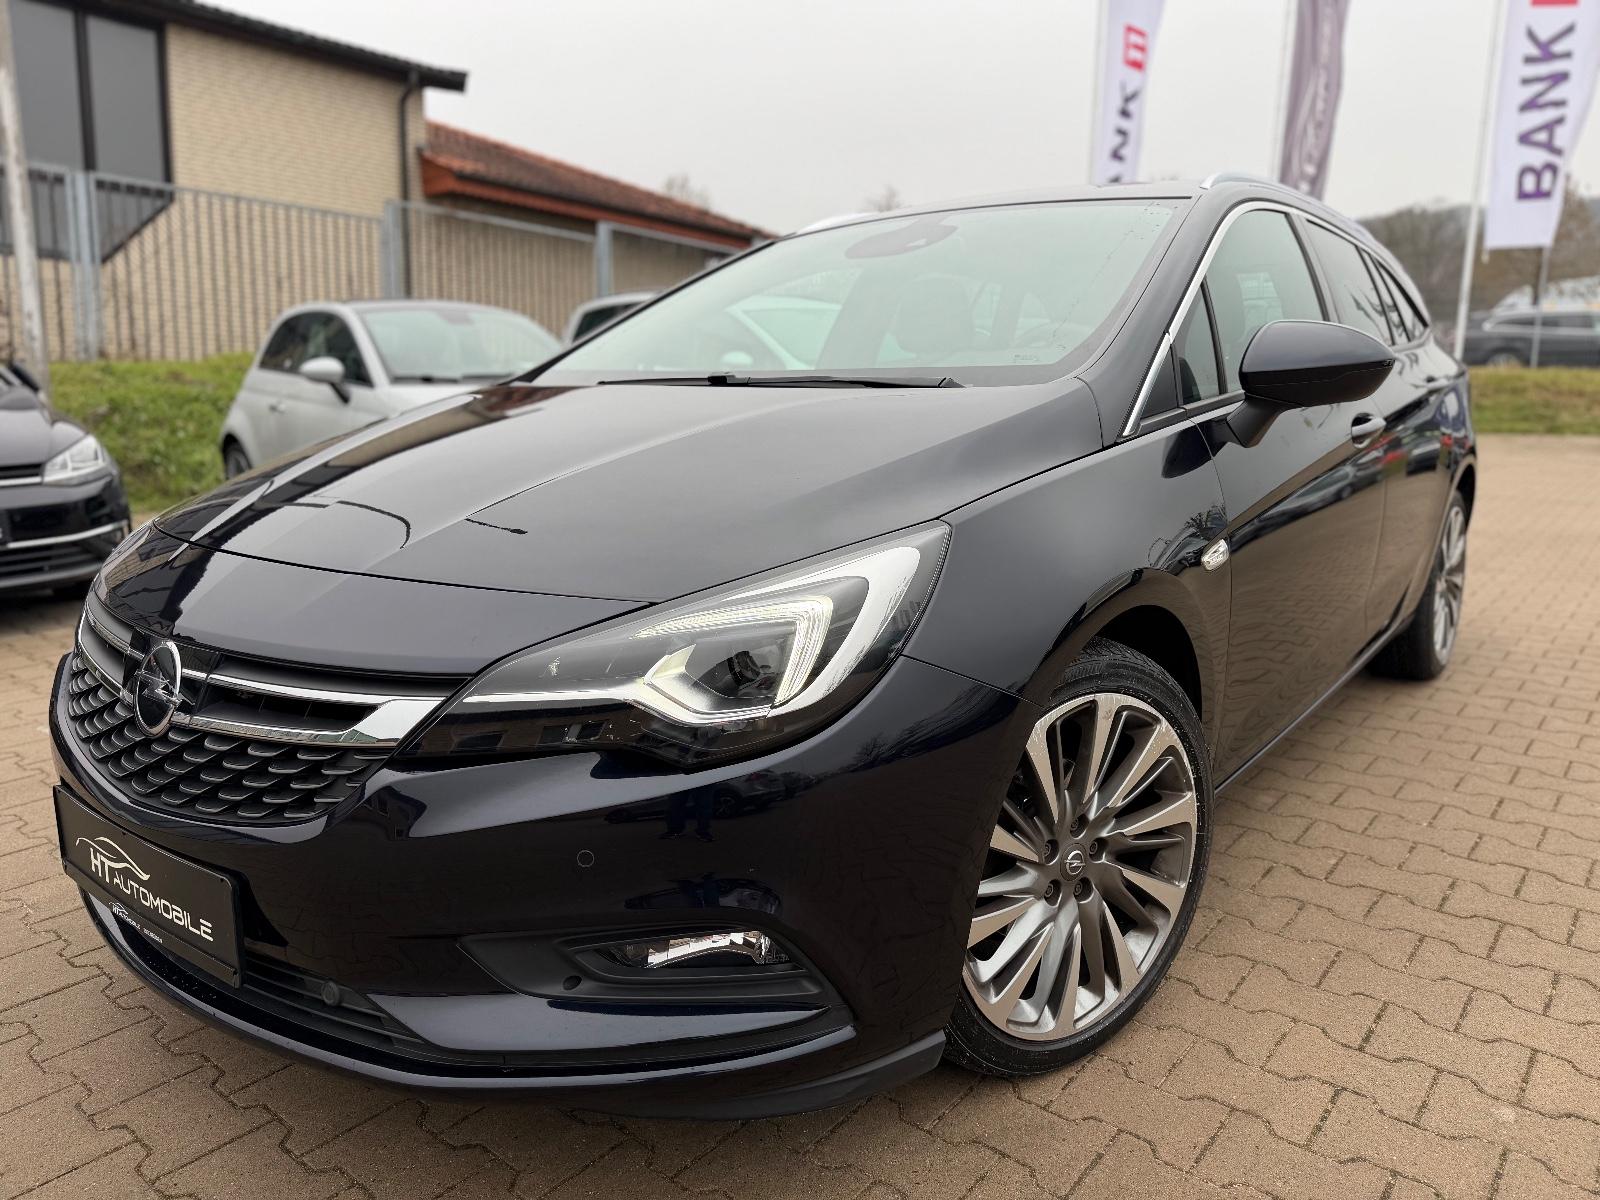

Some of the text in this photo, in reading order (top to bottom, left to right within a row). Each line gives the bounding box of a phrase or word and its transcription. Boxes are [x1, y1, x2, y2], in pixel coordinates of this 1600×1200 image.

[1517, 22, 1576, 202] BANK
[90, 847, 213, 941] HT AUTOMOBILE
